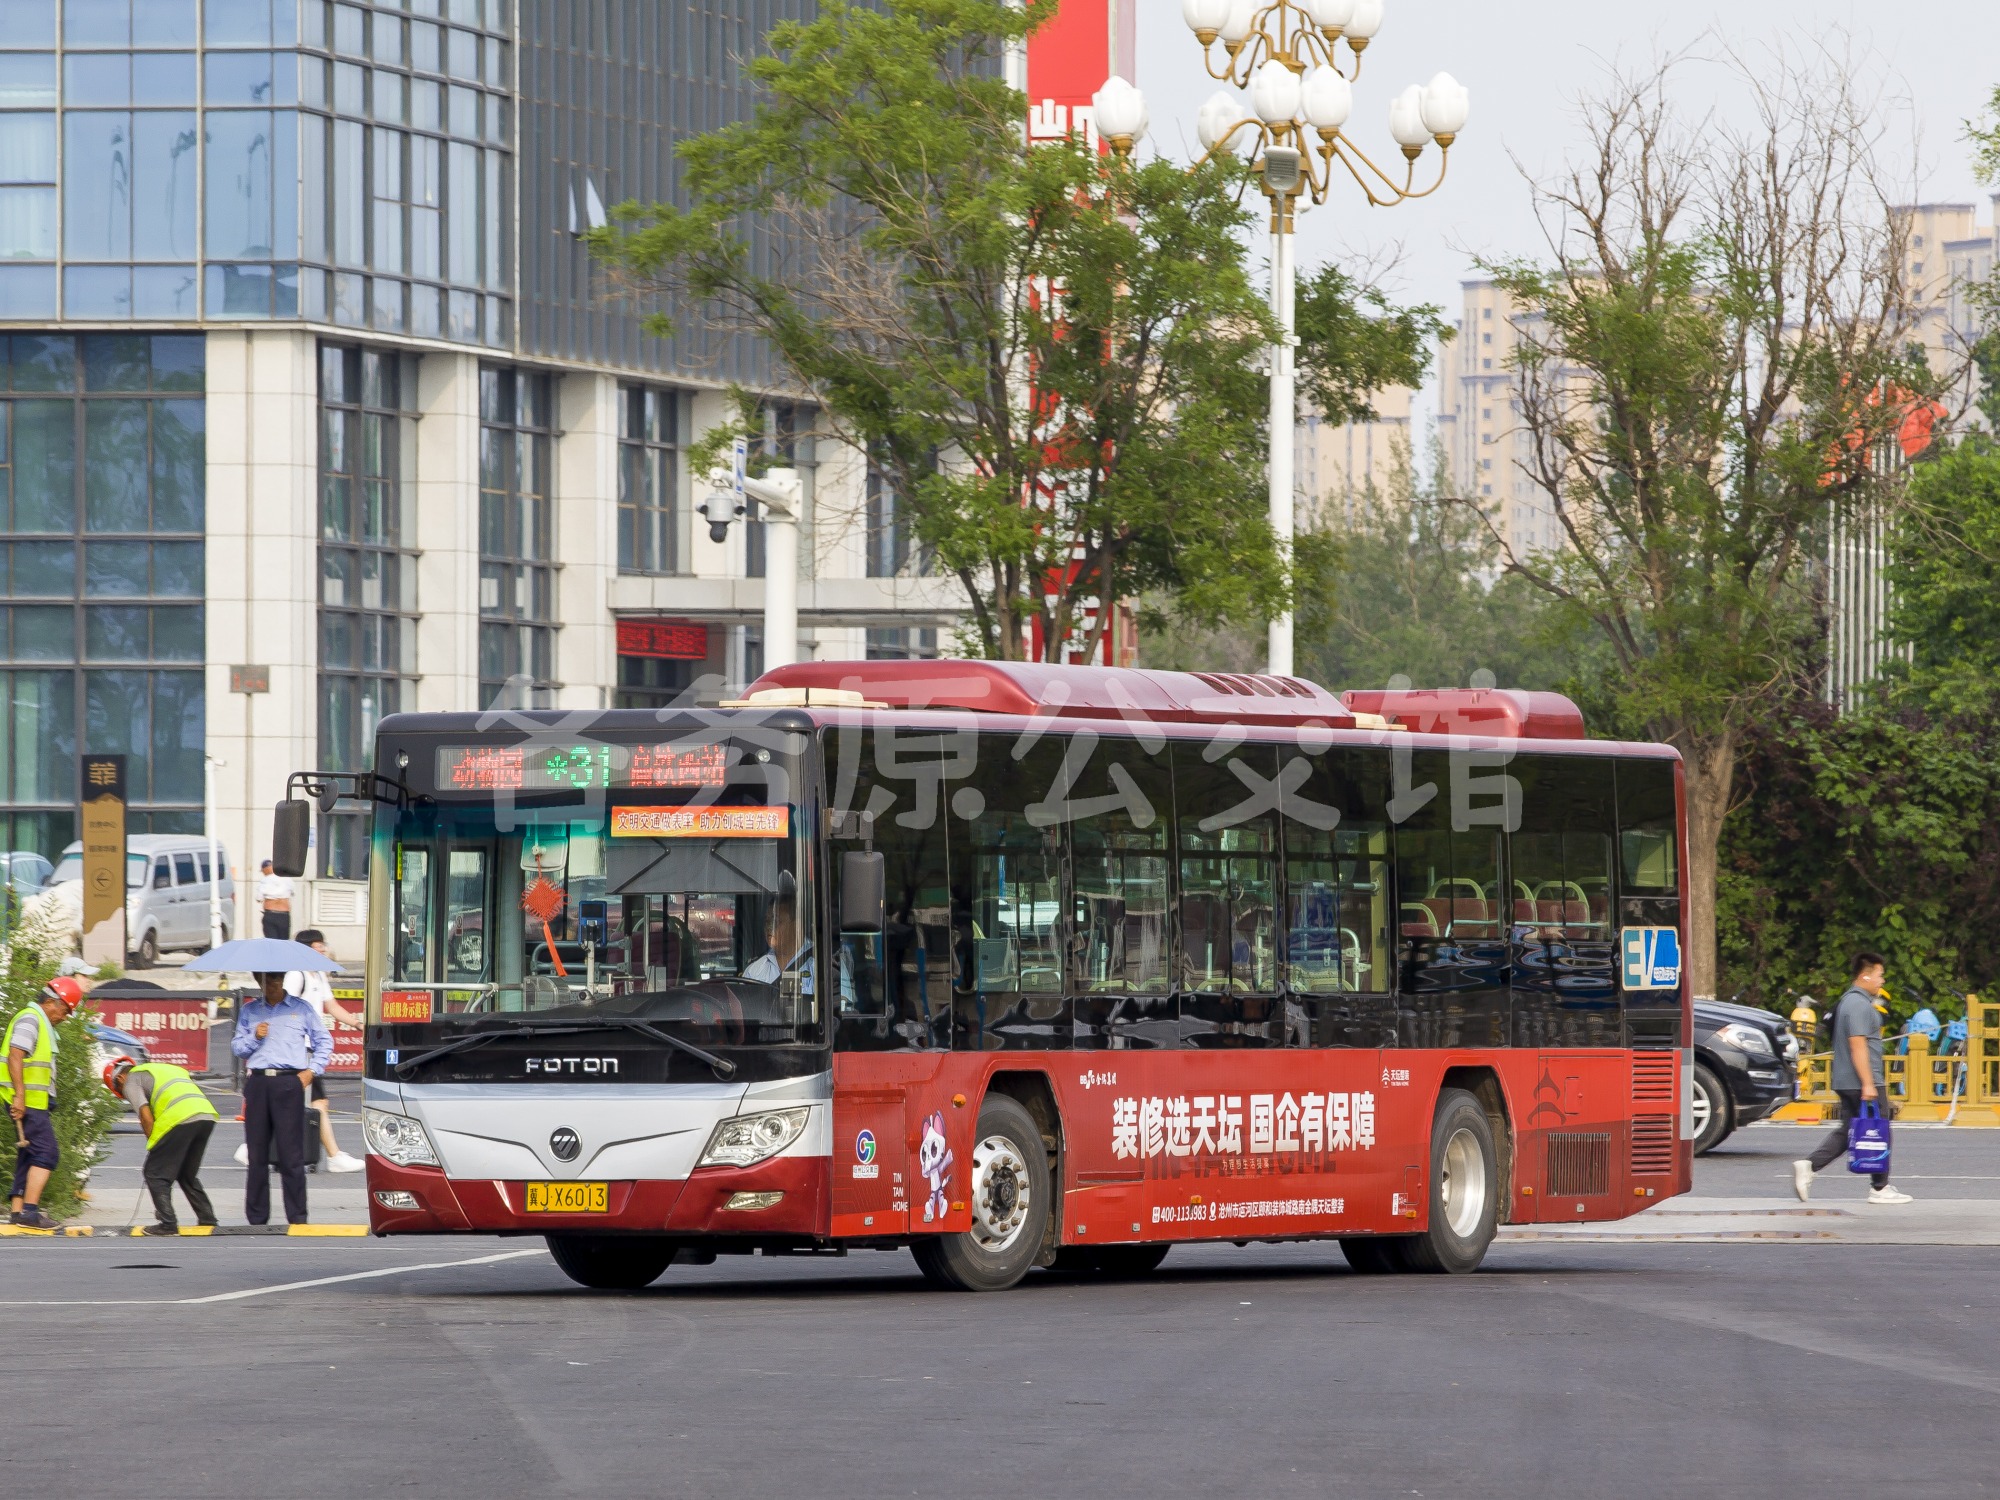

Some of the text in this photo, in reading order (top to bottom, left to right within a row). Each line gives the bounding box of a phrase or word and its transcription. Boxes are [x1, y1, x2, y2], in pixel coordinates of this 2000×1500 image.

[618, 811, 779, 830] 文明交通做表率 助力创城当先锋
[383, 1001, 429, 1018] 优质服务示范车
[525, 1058, 619, 1074] FOTON
[1111, 1094, 1243, 1161] 装修选天坛
[1250, 1090, 1376, 1154] 国企有保障
[892, 1172, 902, 1183] TIN
[892, 1187, 904, 1198] TAN
[892, 1201, 909, 1212] HOME
